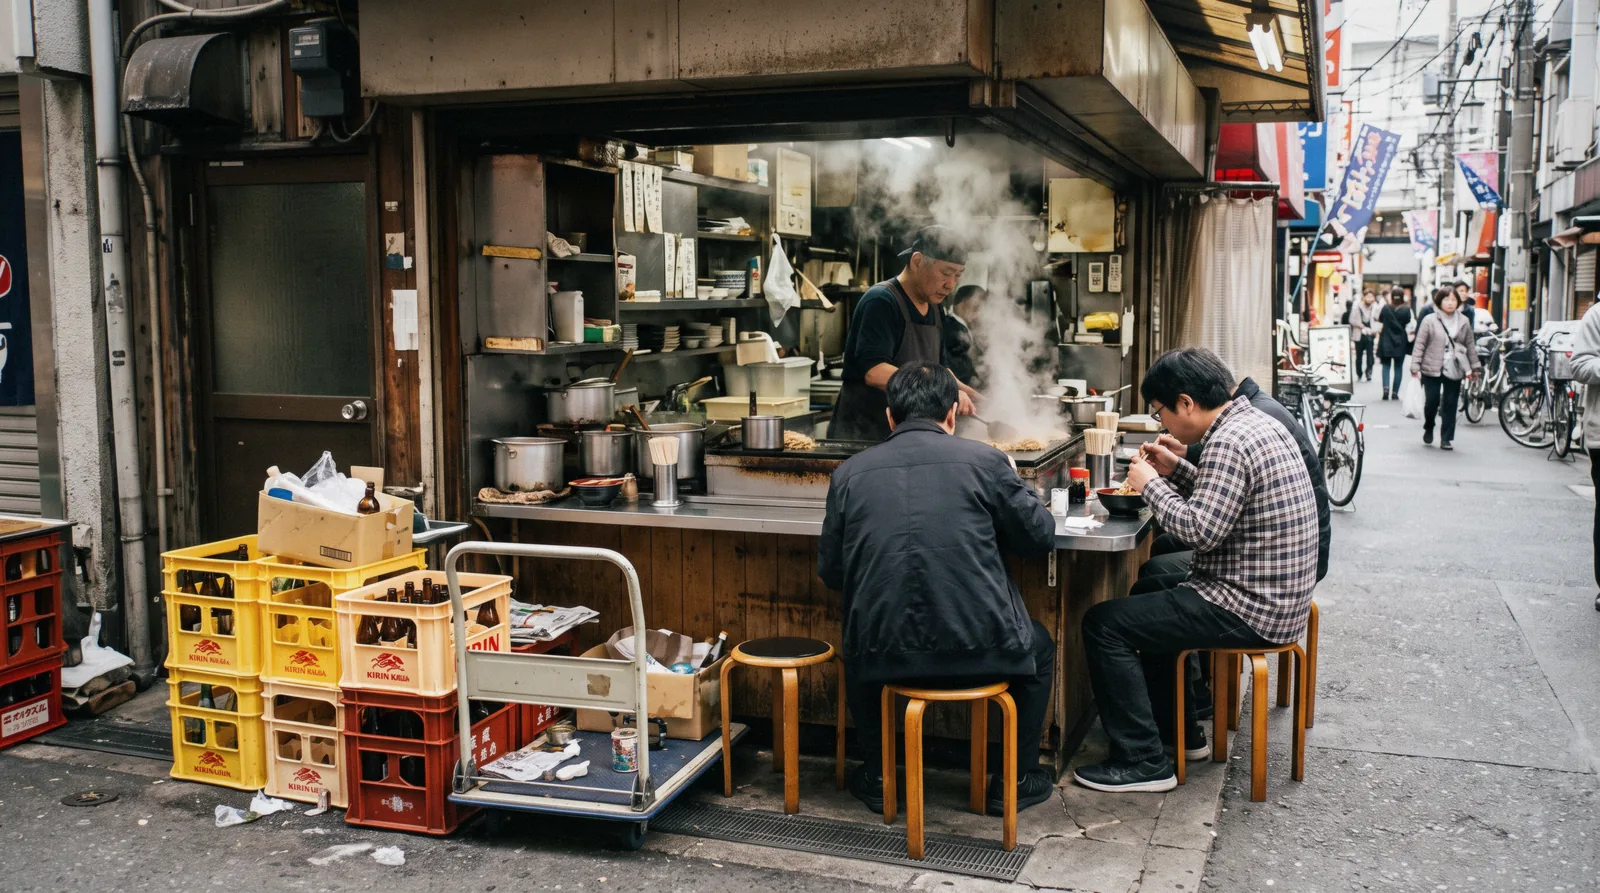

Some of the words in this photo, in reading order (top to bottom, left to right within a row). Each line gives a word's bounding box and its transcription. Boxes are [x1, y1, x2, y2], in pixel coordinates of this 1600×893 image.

[189, 654, 208, 663] KIRIN
[284, 665, 306, 675] KIRIN
[367, 671, 390, 681] KIRIN
[288, 783, 310, 793] KIRIN
